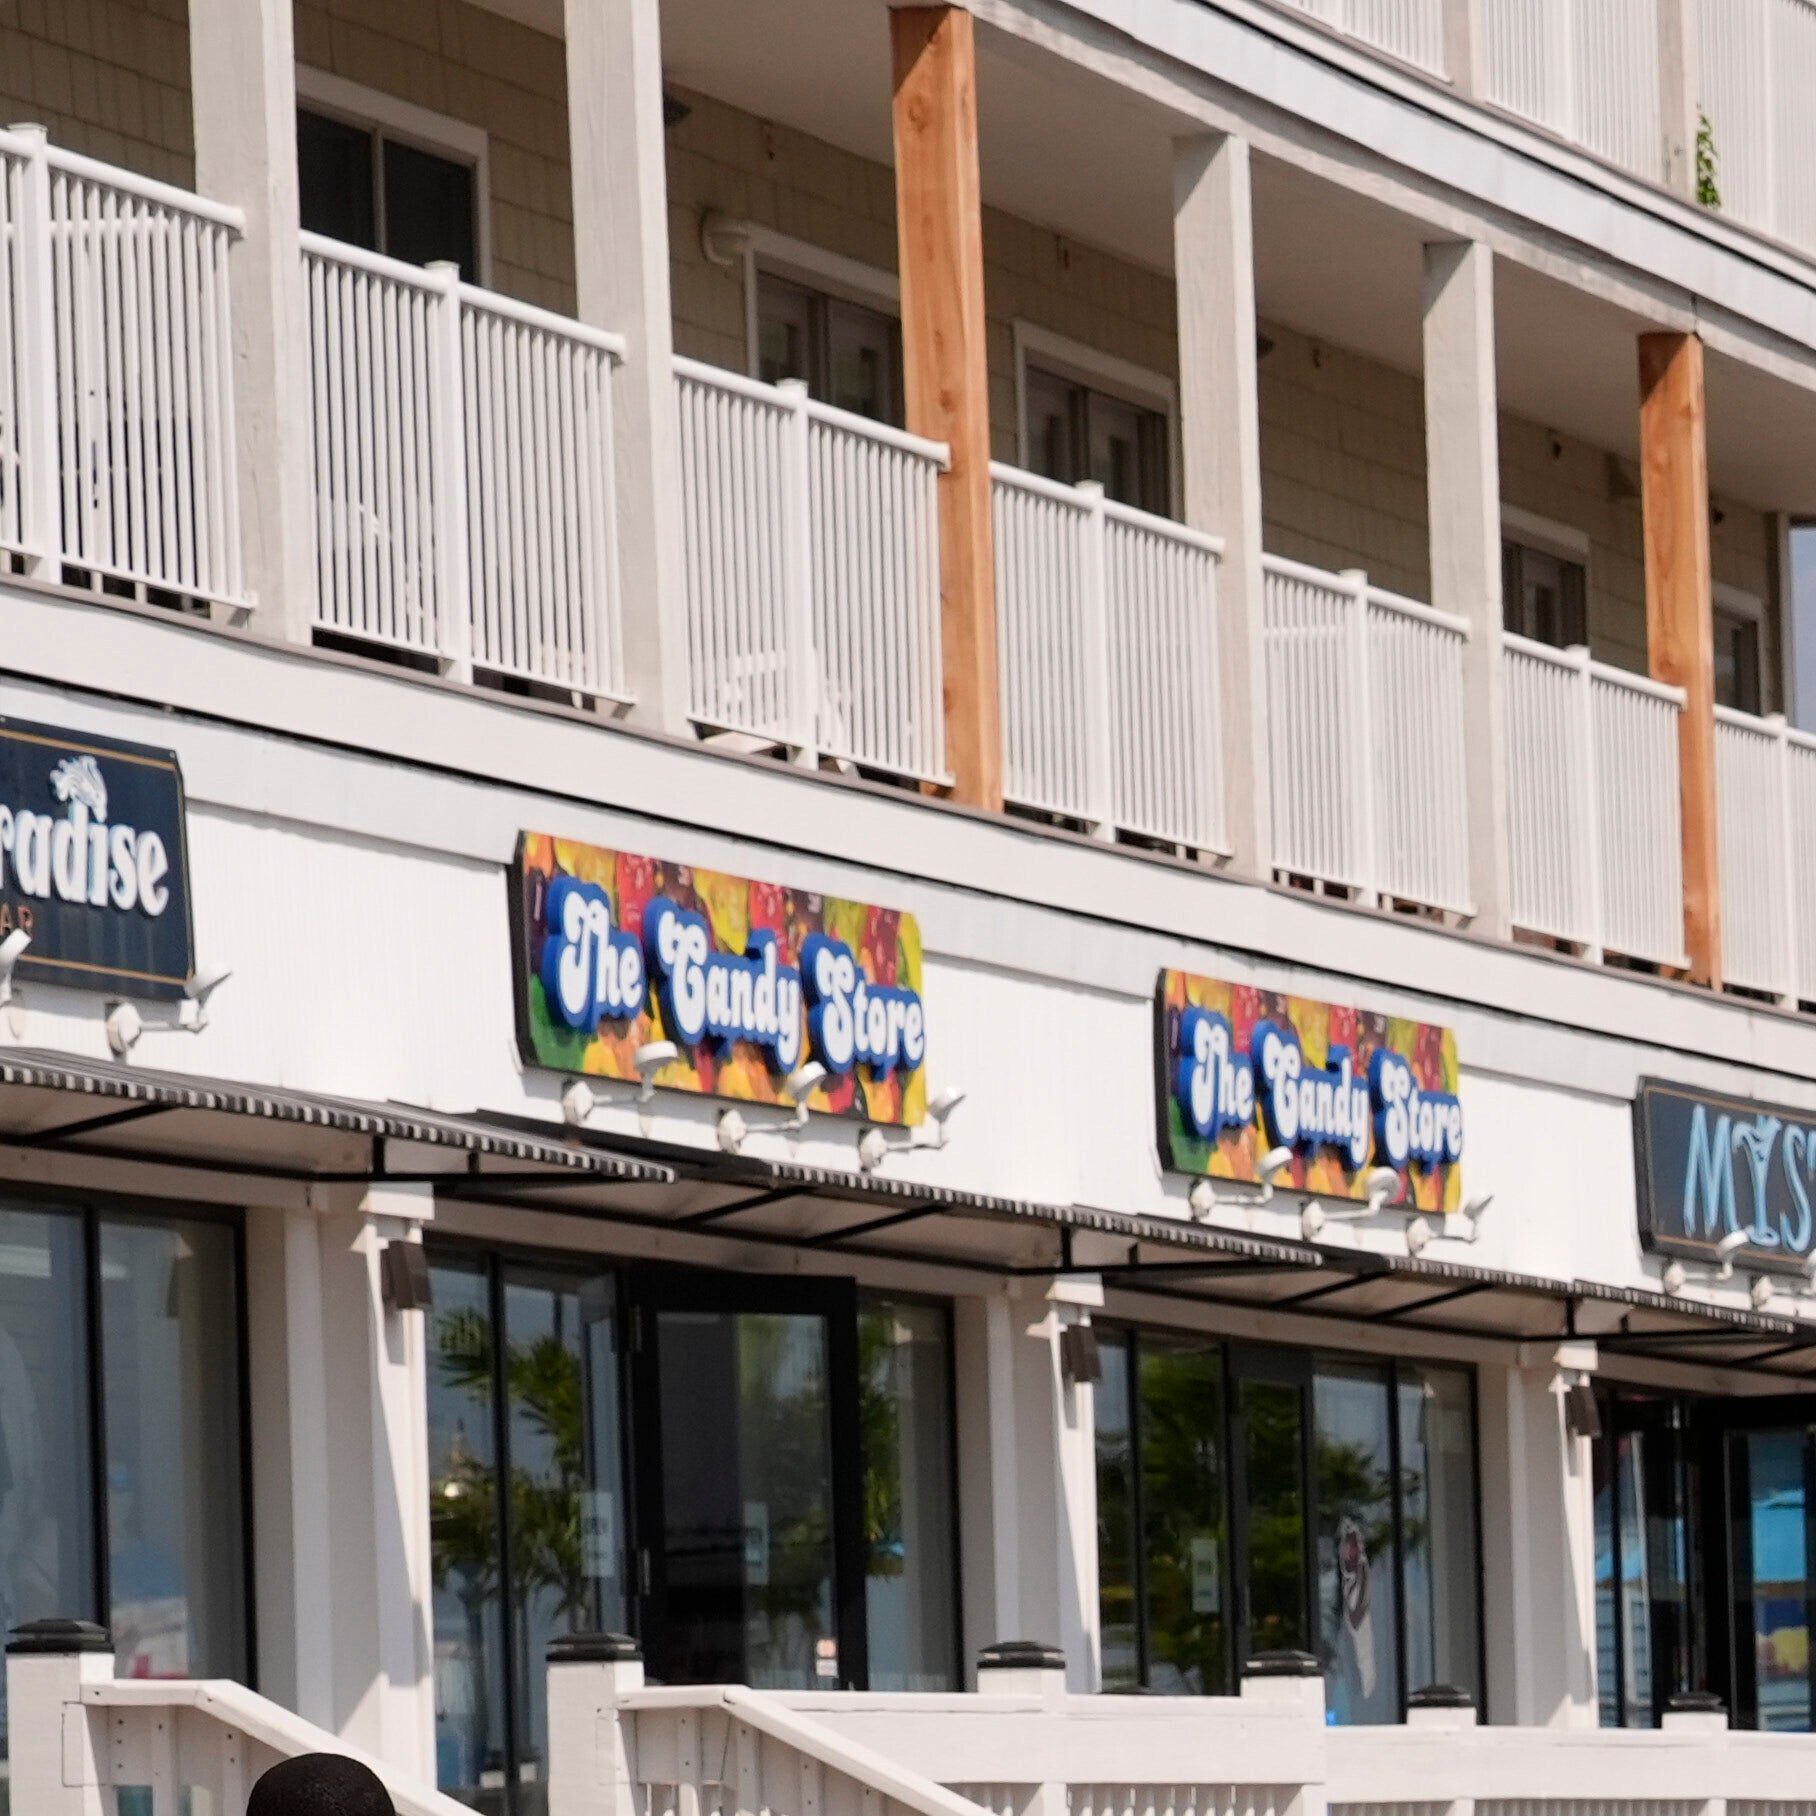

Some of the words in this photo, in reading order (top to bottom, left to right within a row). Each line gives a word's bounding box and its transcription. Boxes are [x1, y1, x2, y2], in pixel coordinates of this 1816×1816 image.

[553, 885, 645, 1020] The
[653, 906, 801, 1069] Candy
[811, 942, 926, 1067] Store
[1187, 1015, 1255, 1129] The
[1260, 1029, 1371, 1167] Candy
[1378, 1055, 1463, 1163] Store
